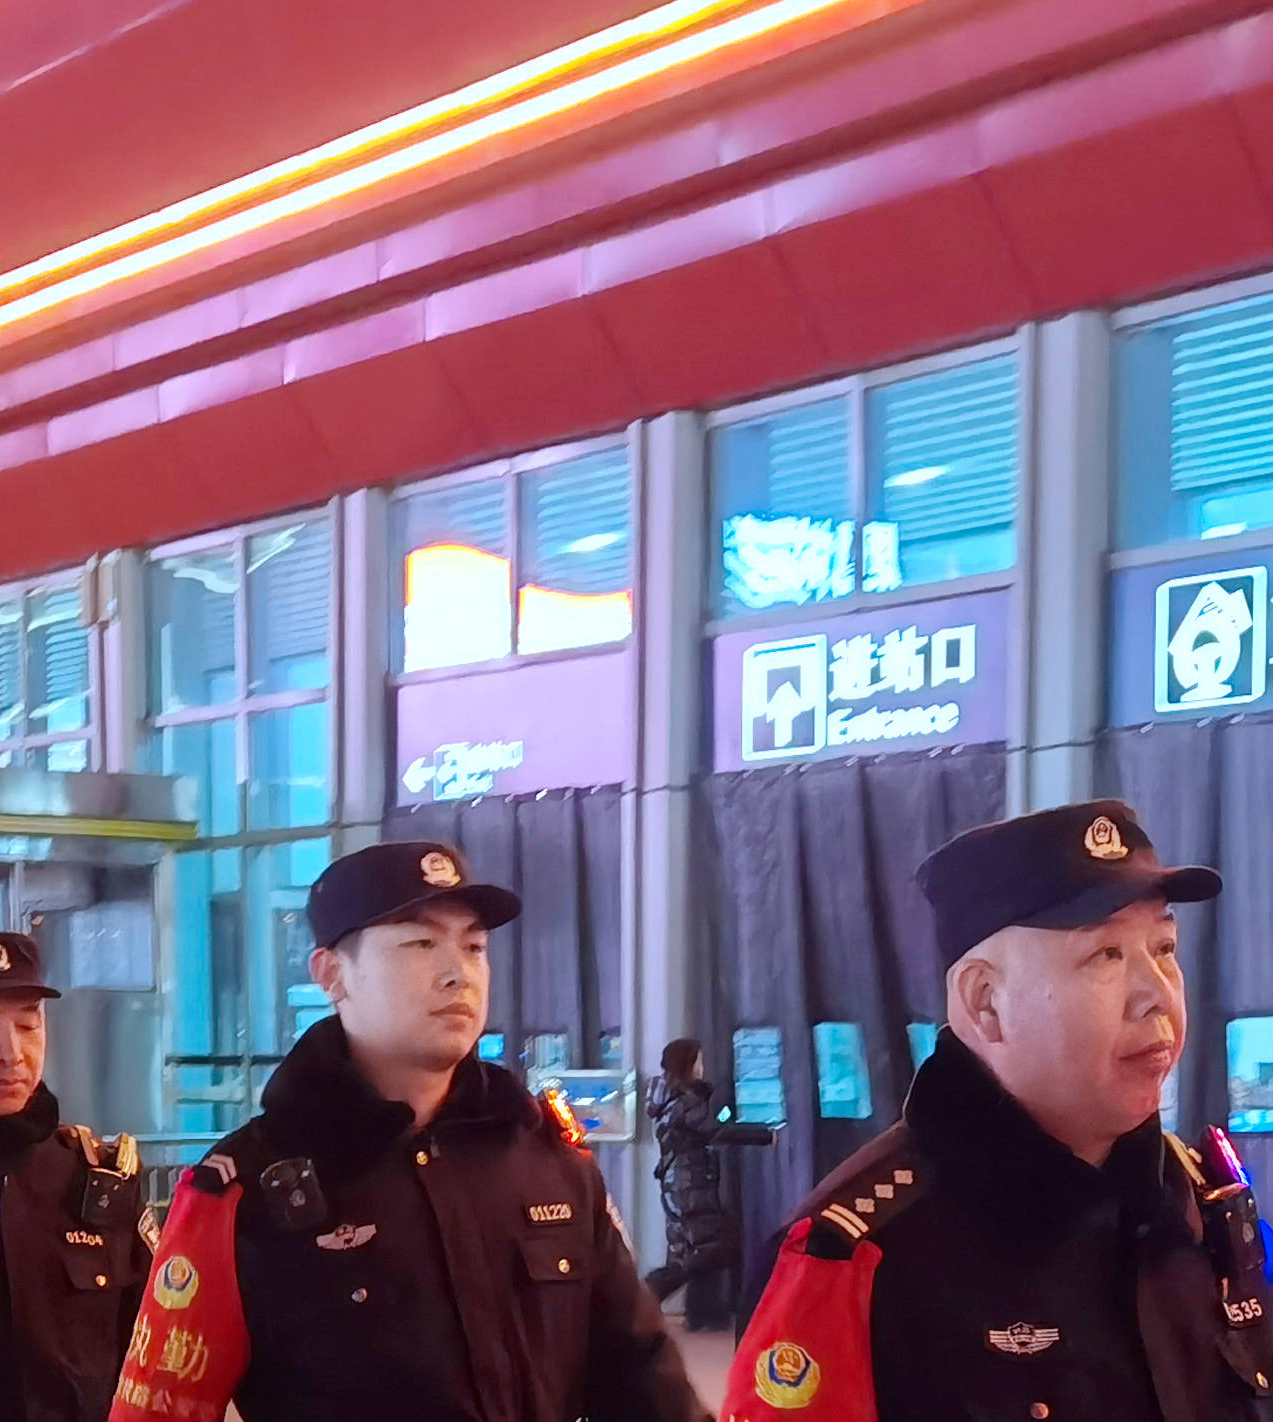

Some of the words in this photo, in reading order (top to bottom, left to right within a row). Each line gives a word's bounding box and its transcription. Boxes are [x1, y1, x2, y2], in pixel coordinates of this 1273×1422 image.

[828, 624, 977, 702] 进站口
[827, 702, 960, 747] Entrance
